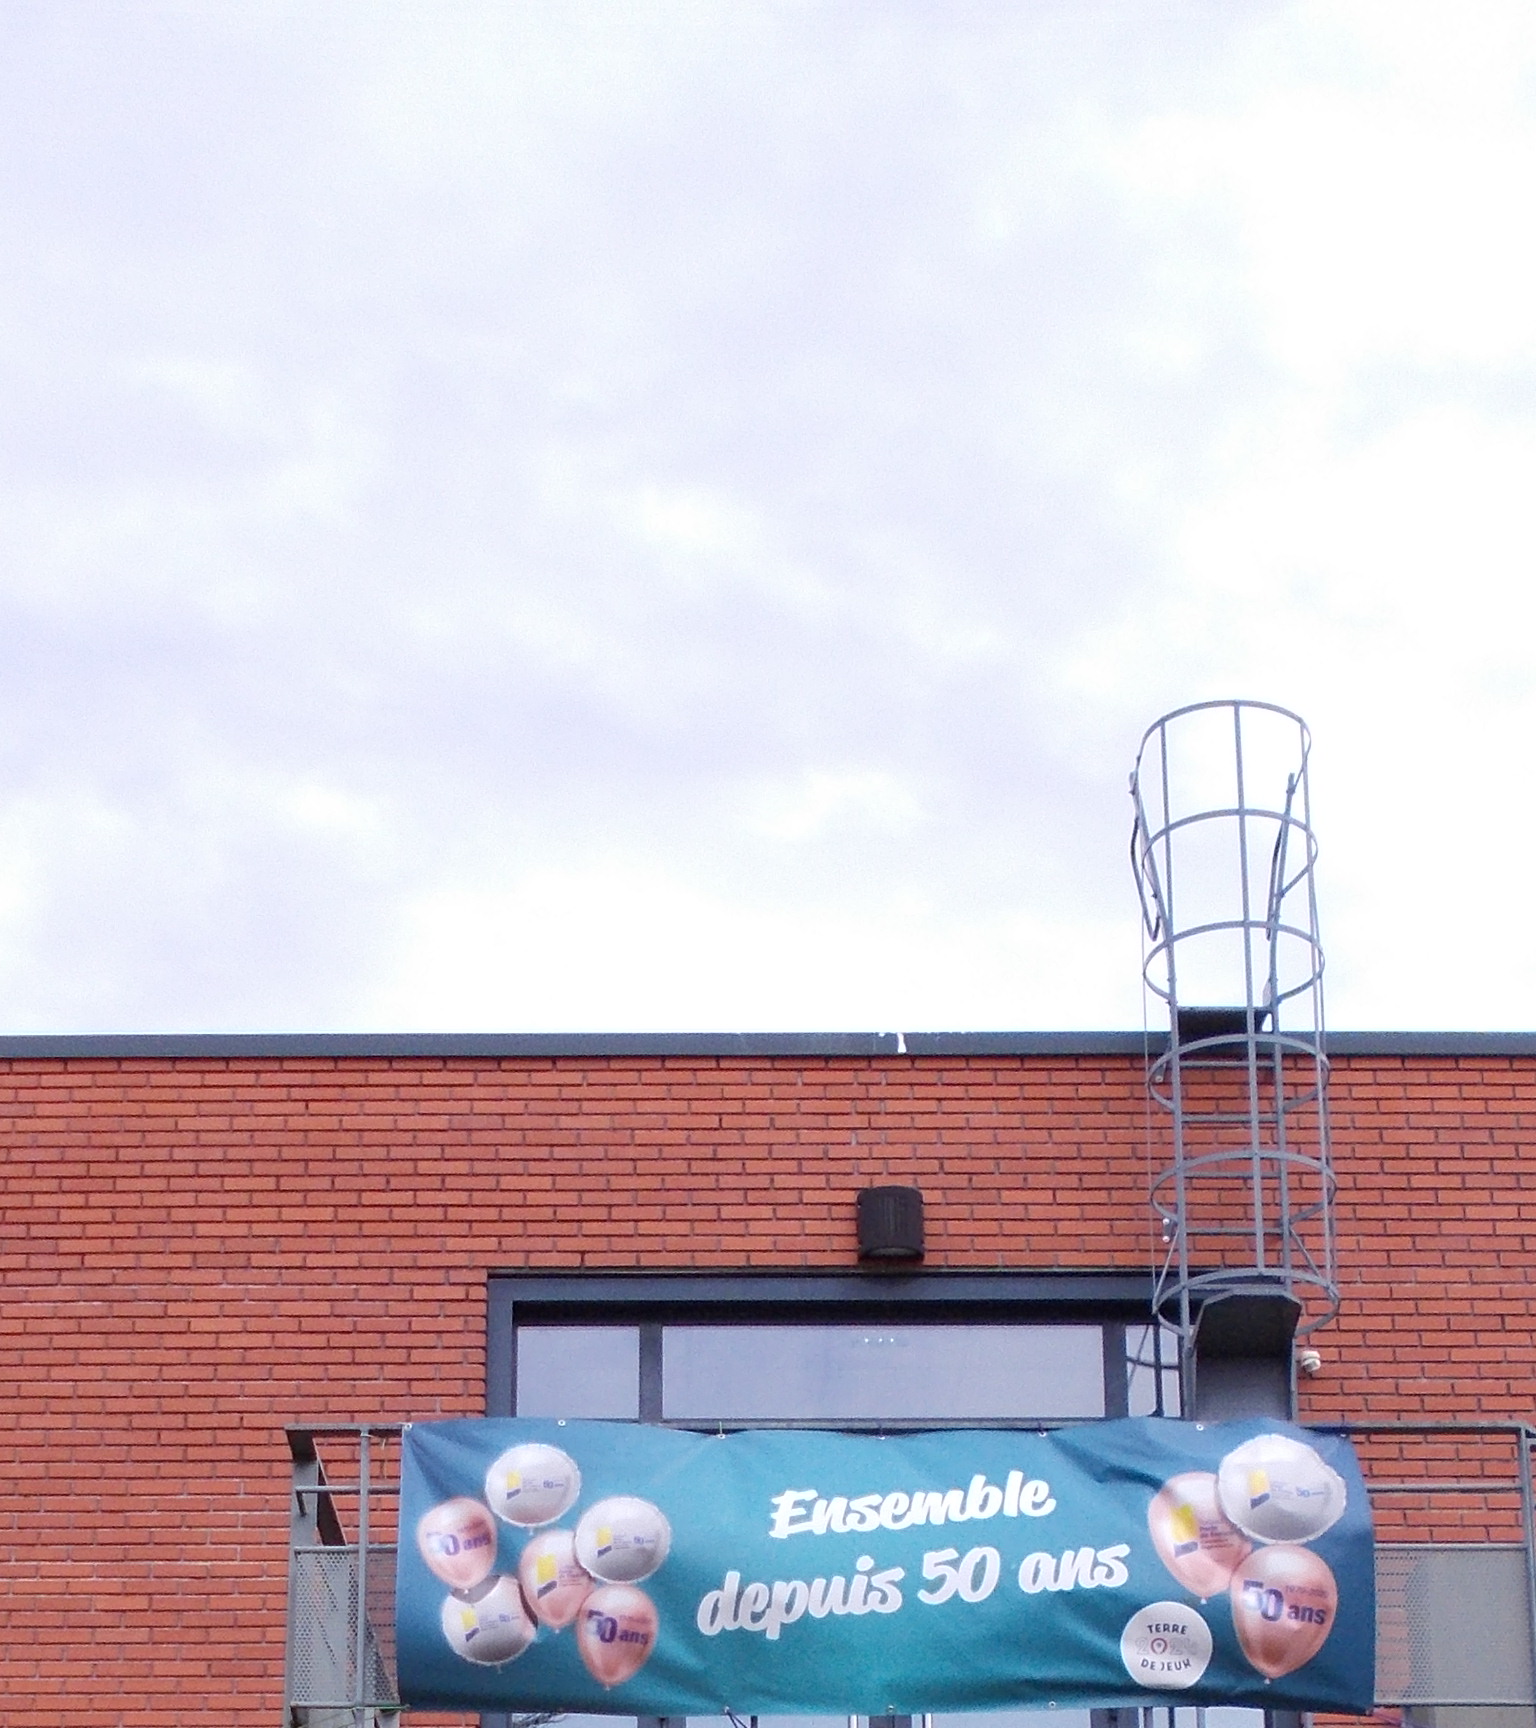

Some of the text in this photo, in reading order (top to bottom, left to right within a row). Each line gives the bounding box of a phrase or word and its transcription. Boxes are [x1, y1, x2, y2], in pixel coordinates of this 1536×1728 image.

[768, 1470, 1057, 1539] Ensemble
[463, 1534, 493, 1551] ans
[697, 1543, 1131, 1640] depuis 50 ans
[1288, 1603, 1327, 1626] ans
[619, 1629, 650, 1646] ans
[1147, 1623, 1189, 1635] TERRE
[1141, 1658, 1192, 1671] DE JEUX
